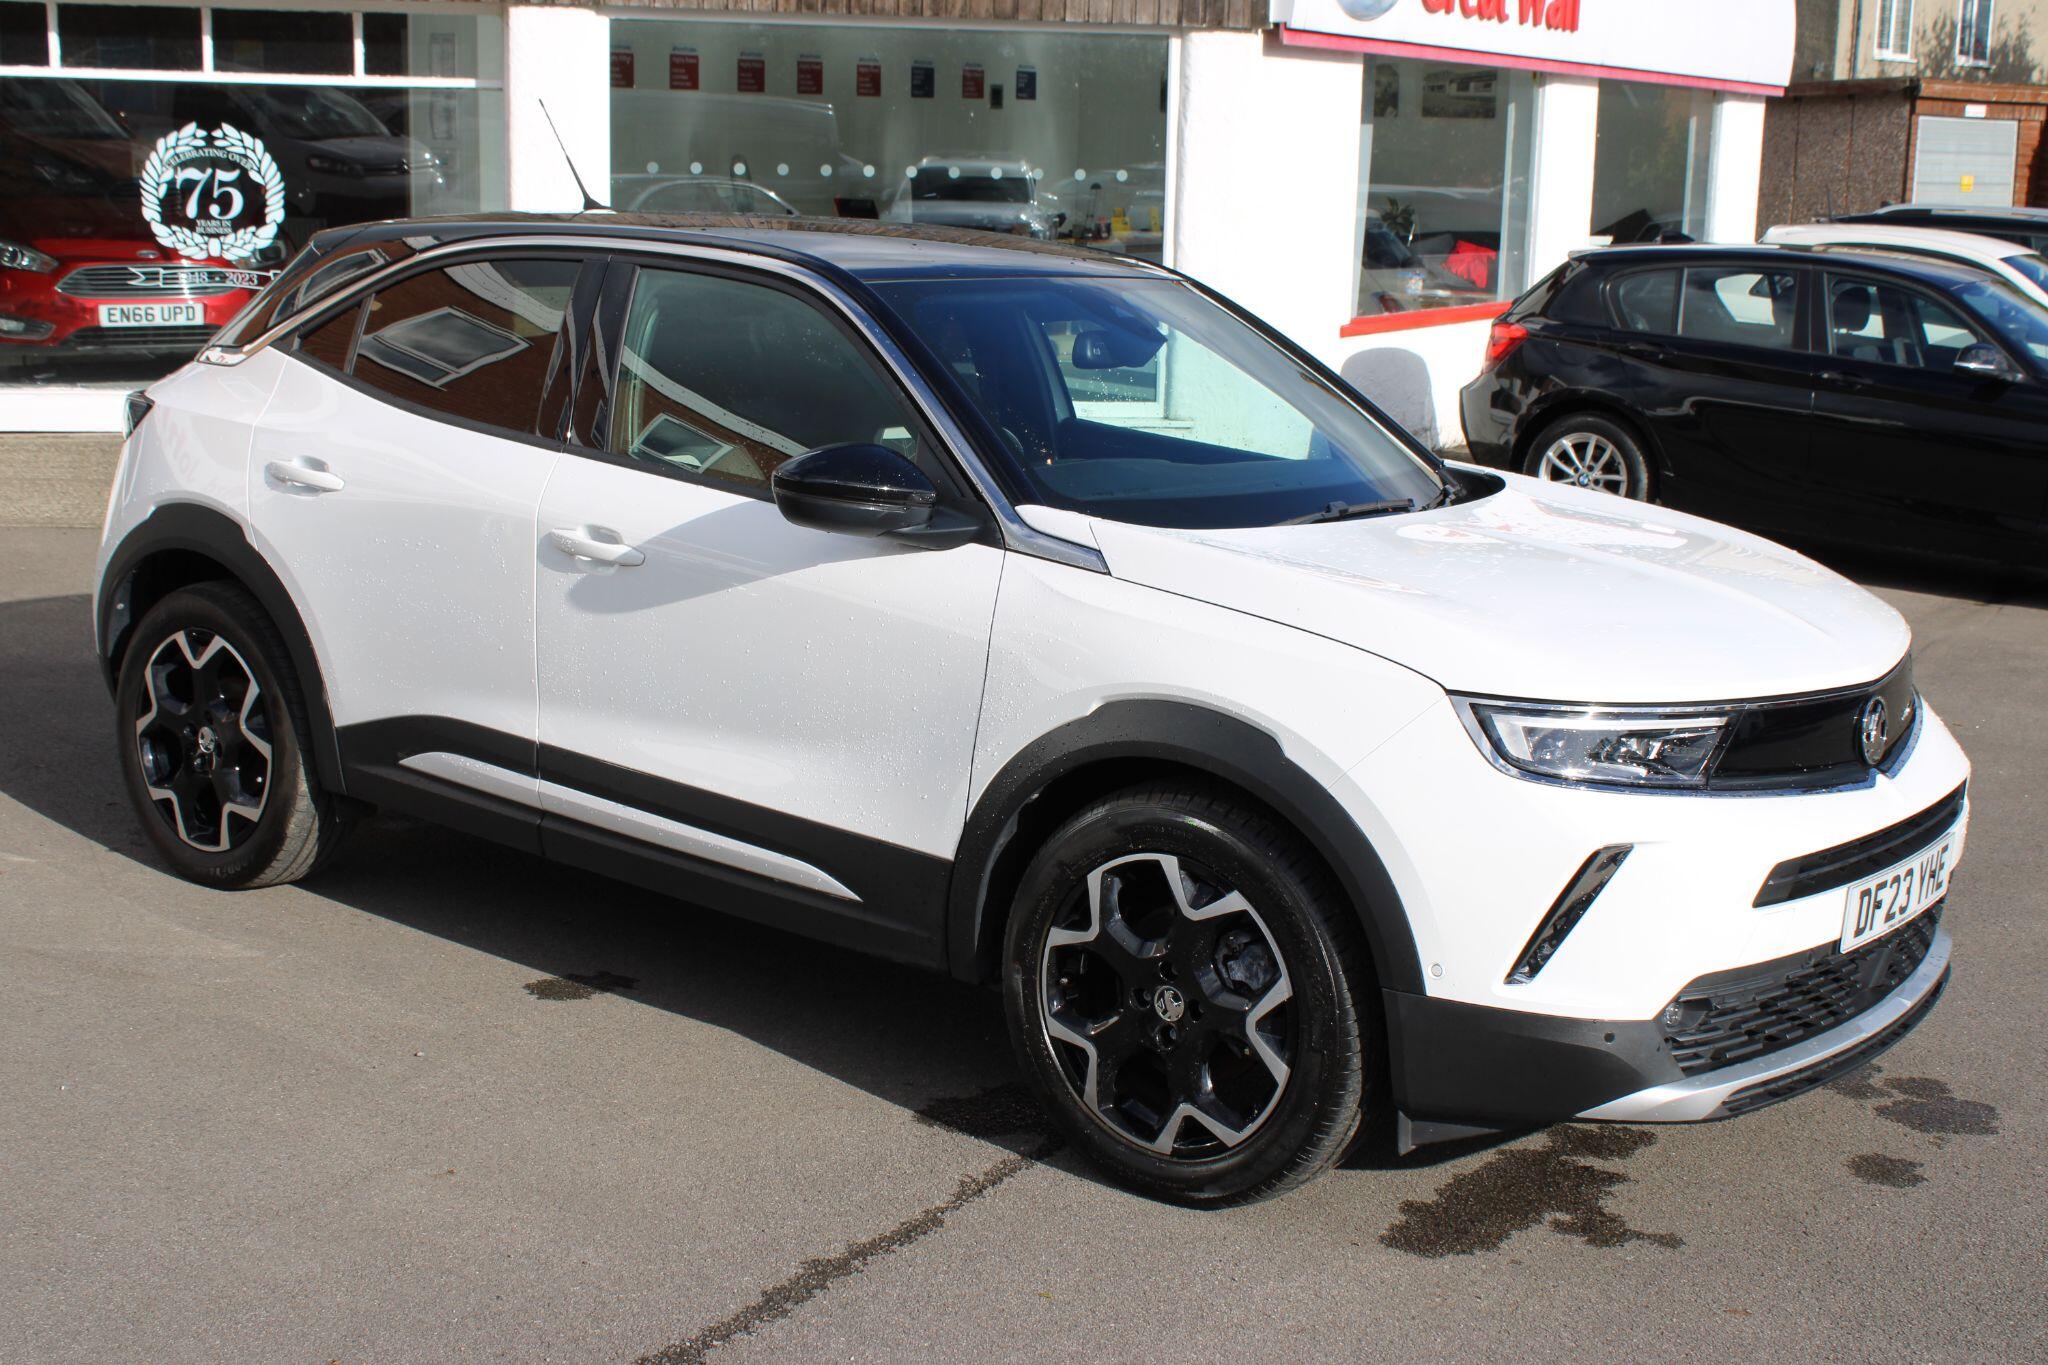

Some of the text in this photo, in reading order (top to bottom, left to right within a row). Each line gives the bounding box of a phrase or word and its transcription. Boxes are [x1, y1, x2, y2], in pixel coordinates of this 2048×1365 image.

[164, 147, 228, 169] CELEBRATING
[175, 166, 244, 220] 75
[225, 272, 258, 286] 2023
[107, 305, 196, 323] EN66 UPD
[1853, 844, 1949, 938] DF23 YHE
